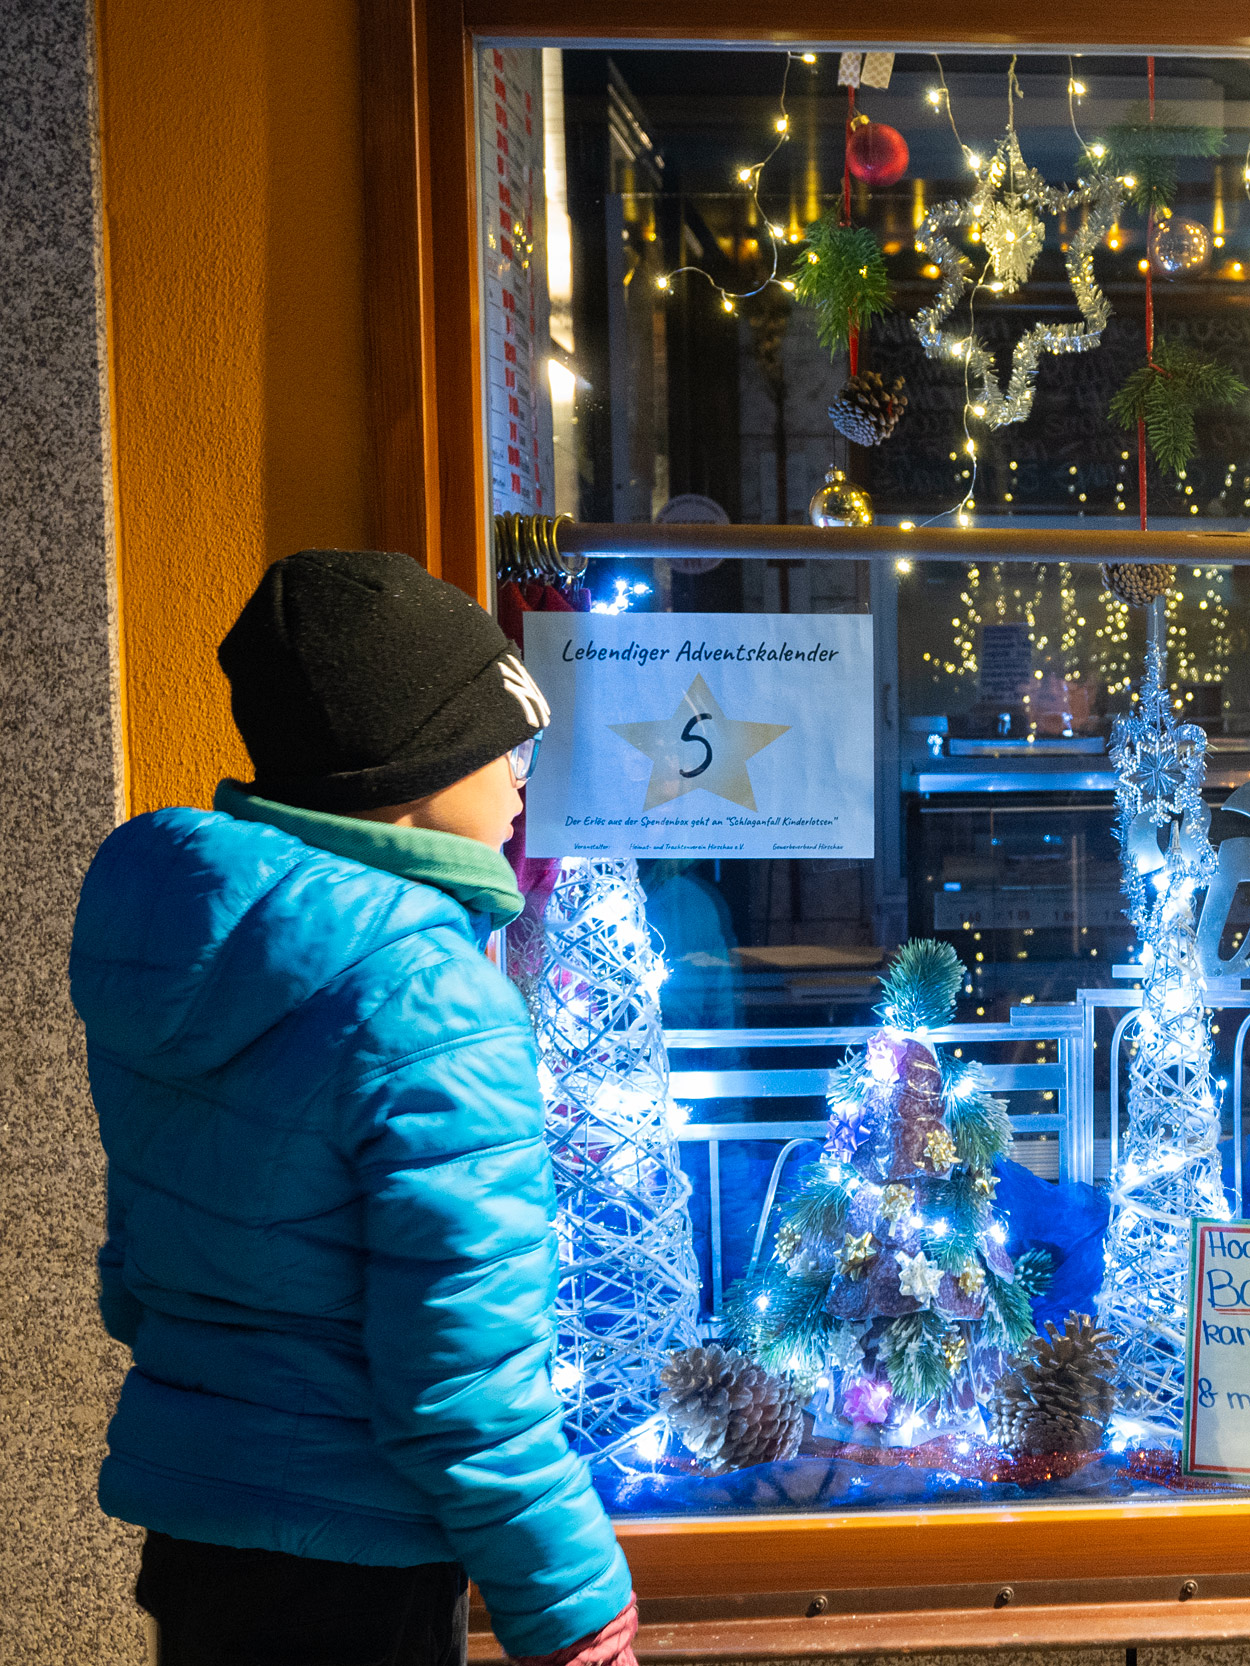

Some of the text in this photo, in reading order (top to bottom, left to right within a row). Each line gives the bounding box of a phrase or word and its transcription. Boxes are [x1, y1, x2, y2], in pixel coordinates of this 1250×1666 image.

[562, 639, 839, 666] Lebendiger Adventskalender
[678, 712, 713, 779] 5
[565, 815, 582, 827] Der
[583, 816, 605, 826] Erlös
[608, 818, 622, 826] aus
[624, 816, 638, 826] der
[640, 816, 689, 828] Spendenbox
[690, 816, 710, 828] geht
[1198, 1377, 1218, 1409] &
